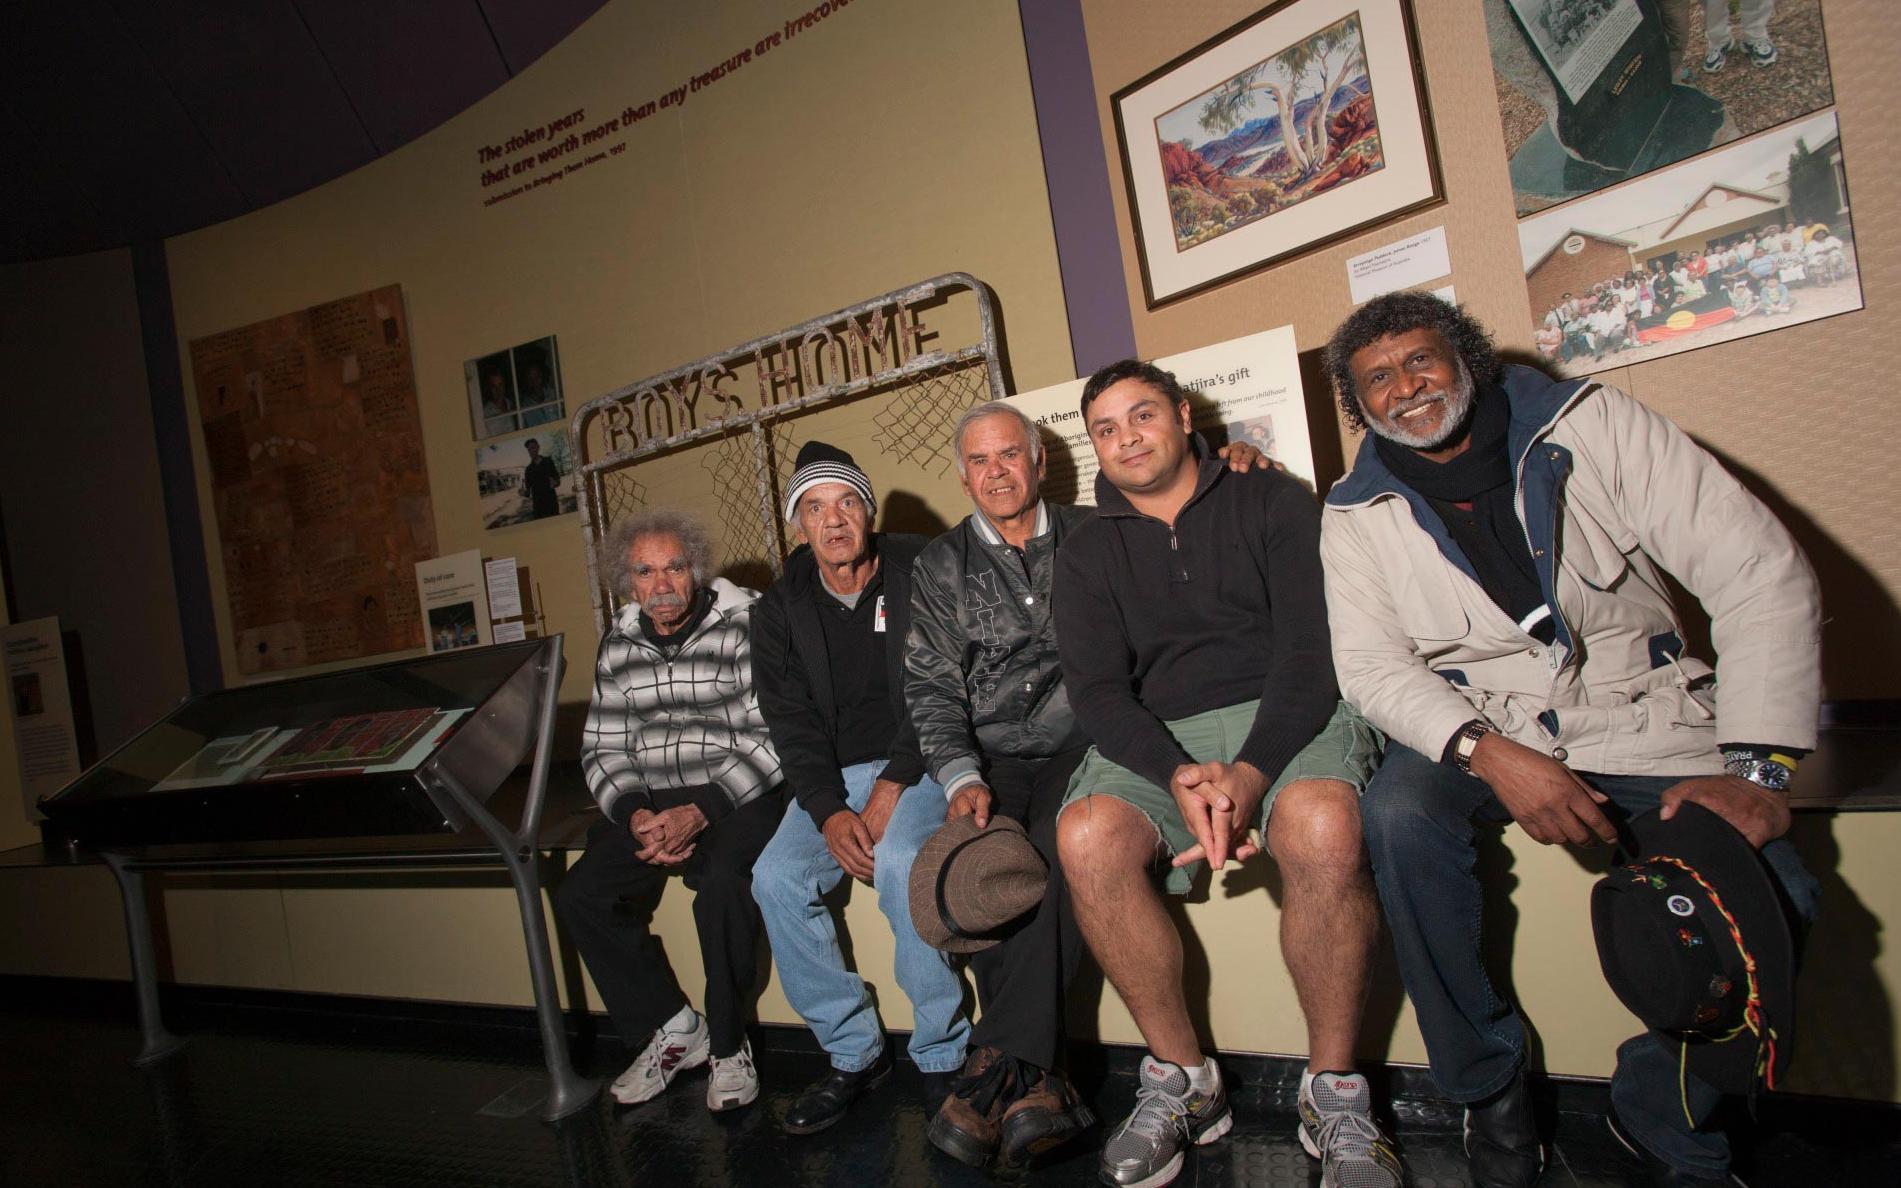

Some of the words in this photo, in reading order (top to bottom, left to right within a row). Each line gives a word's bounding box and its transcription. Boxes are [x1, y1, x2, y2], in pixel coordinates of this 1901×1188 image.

[481, 164, 510, 187] that
[513, 156, 535, 175] are
[538, 134, 579, 164] worth
[582, 118, 619, 145] more
[622, 100, 656, 127] than
[660, 84, 687, 109] any
[690, 48, 752, 93] treasure
[755, 31, 781, 56] are
[478, 145, 502, 164] The
[505, 127, 545, 154] stolen
[547, 108, 585, 141] years
[600, 362, 733, 456] BOYS
[754, 287, 939, 409] HOME
[1183, 374, 1224, 393] atjira's
[1228, 367, 1251, 385] gift
[1050, 410, 1079, 424] them
[1227, 397, 1242, 407] from
[1243, 394, 1254, 402] our
[1256, 387, 1287, 400] childhood
